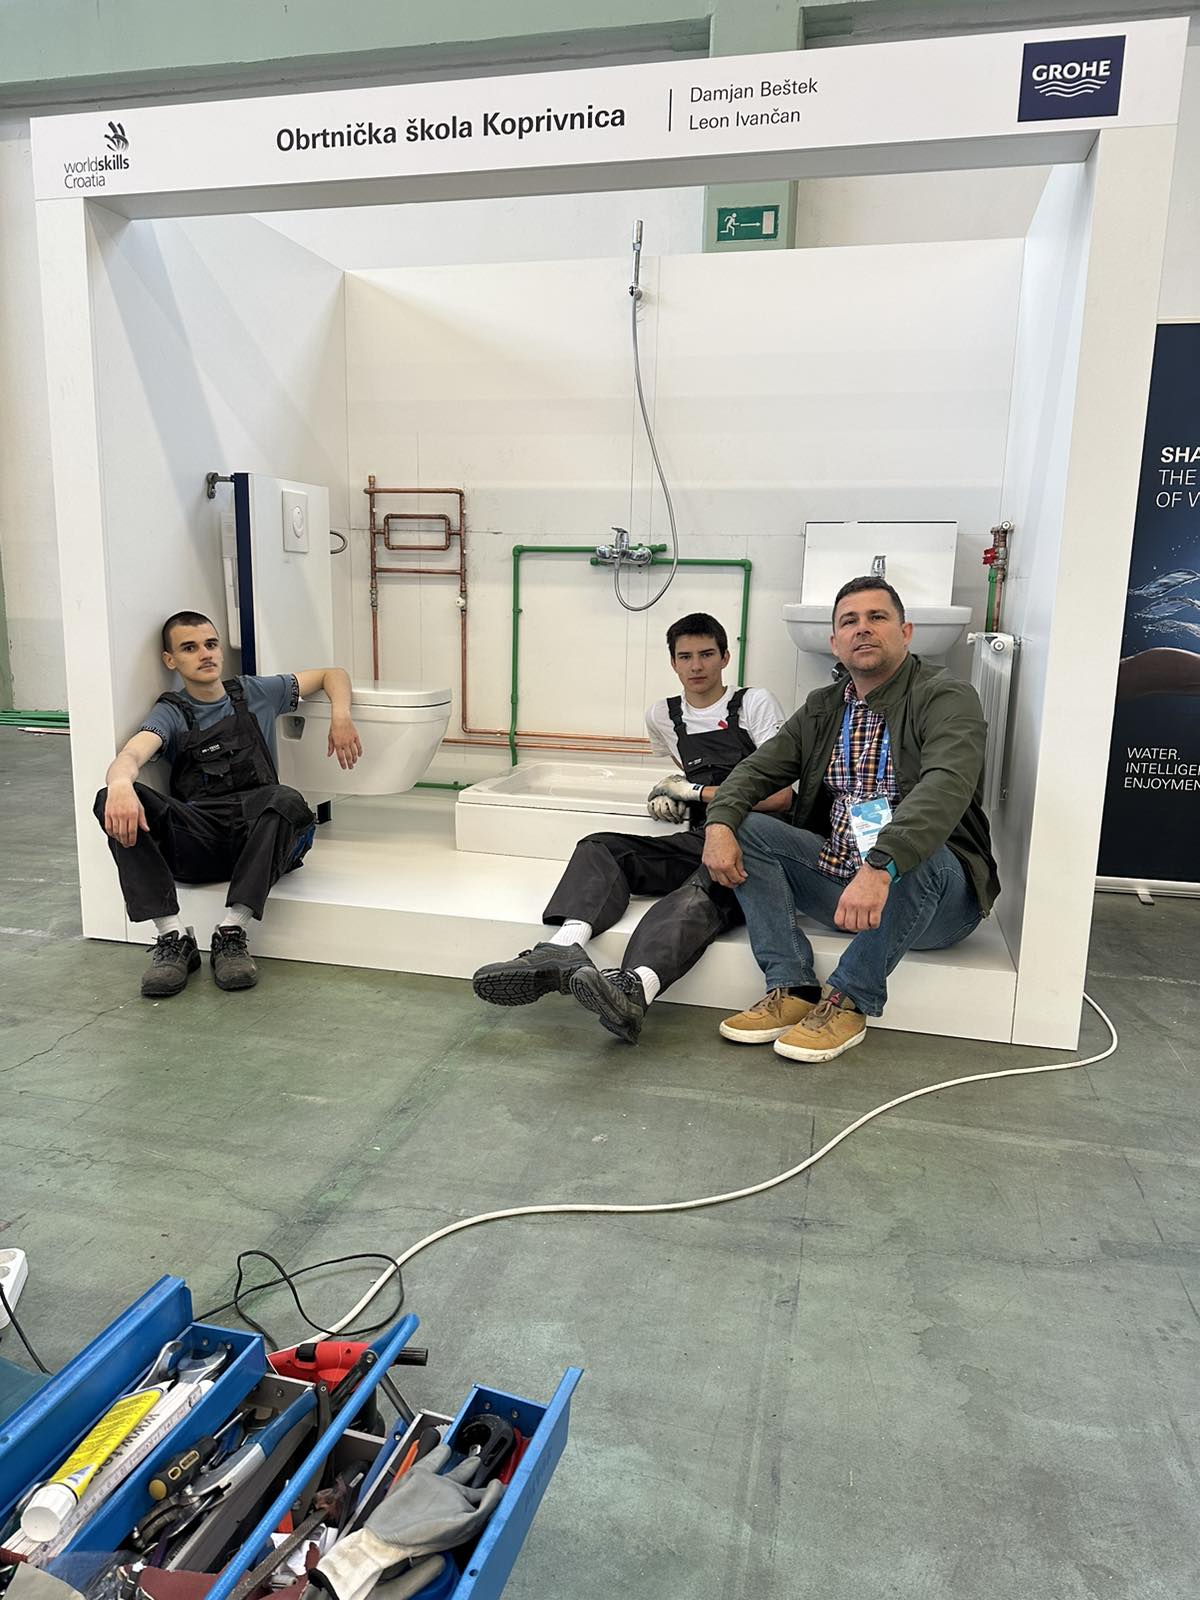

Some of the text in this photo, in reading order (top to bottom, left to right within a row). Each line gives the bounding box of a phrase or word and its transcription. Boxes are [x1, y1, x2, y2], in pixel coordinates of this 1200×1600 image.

[1032, 60, 1111, 81] GROHE
[690, 77, 818, 103] Damjan Beštek
[276, 105, 625, 151] Obrtnička škola Koprivnica
[689, 108, 801, 130] Leon Ivančan
[63, 154, 130, 173] worldskills
[64, 172, 105, 189] Croatia
[1160, 446, 1200, 463] SHA
[1158, 469, 1197, 486] THE
[1156, 491, 1182, 508] OF
[1127, 747, 1181, 760] WATER.
